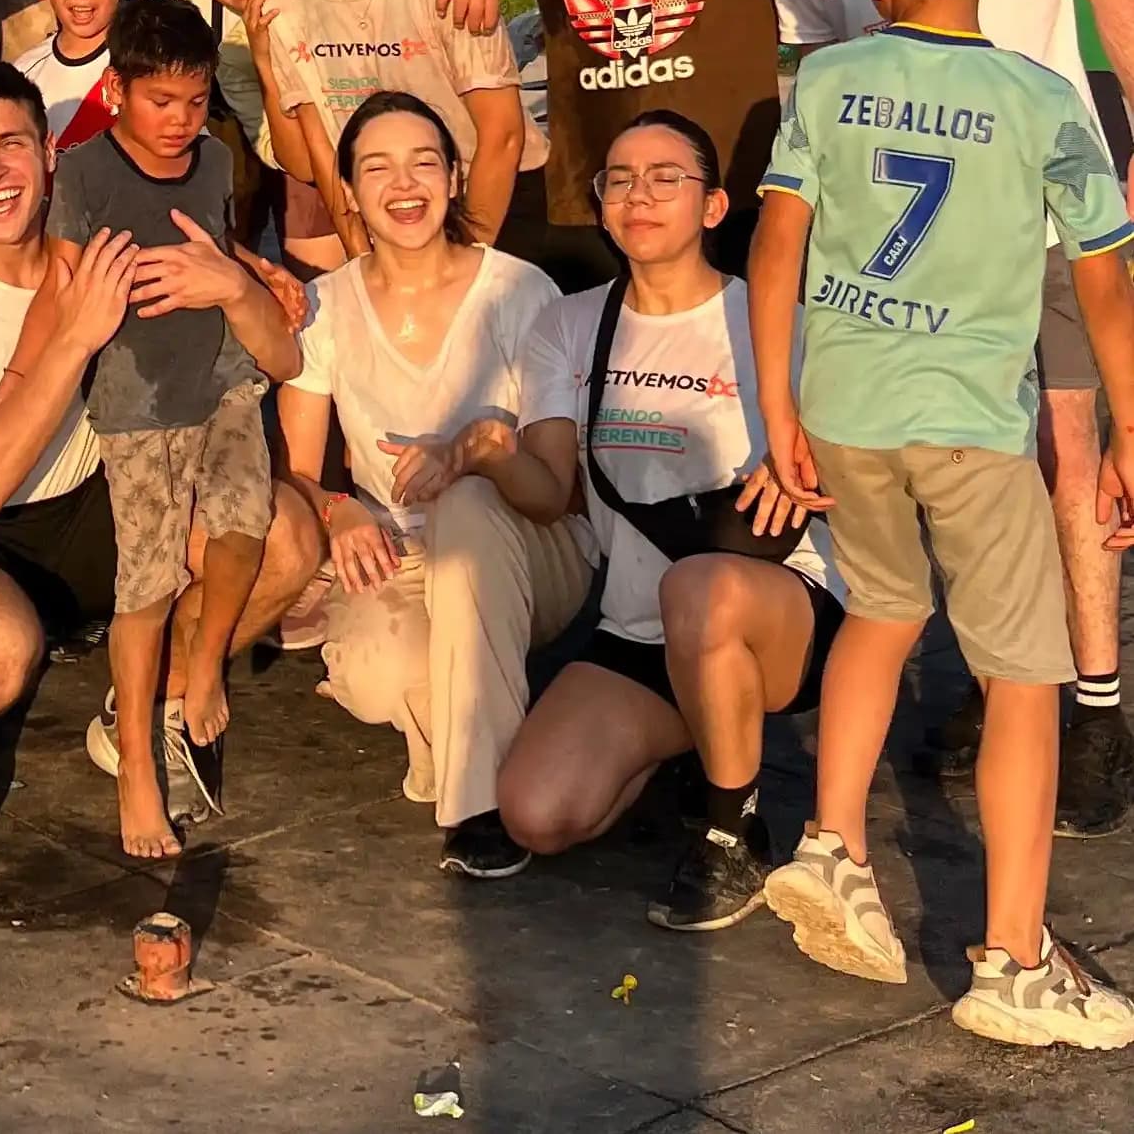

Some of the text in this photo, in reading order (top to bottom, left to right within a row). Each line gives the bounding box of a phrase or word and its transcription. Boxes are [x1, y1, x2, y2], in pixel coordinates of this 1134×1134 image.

[311, 42, 402, 59] CTIVEMOS
[613, 34, 653, 49] adidas
[579, 55, 695, 91] adidas
[837, 94, 996, 145] ZEBALLOS
[860, 147, 956, 282] 7
[811, 274, 949, 335] DIRECTV
